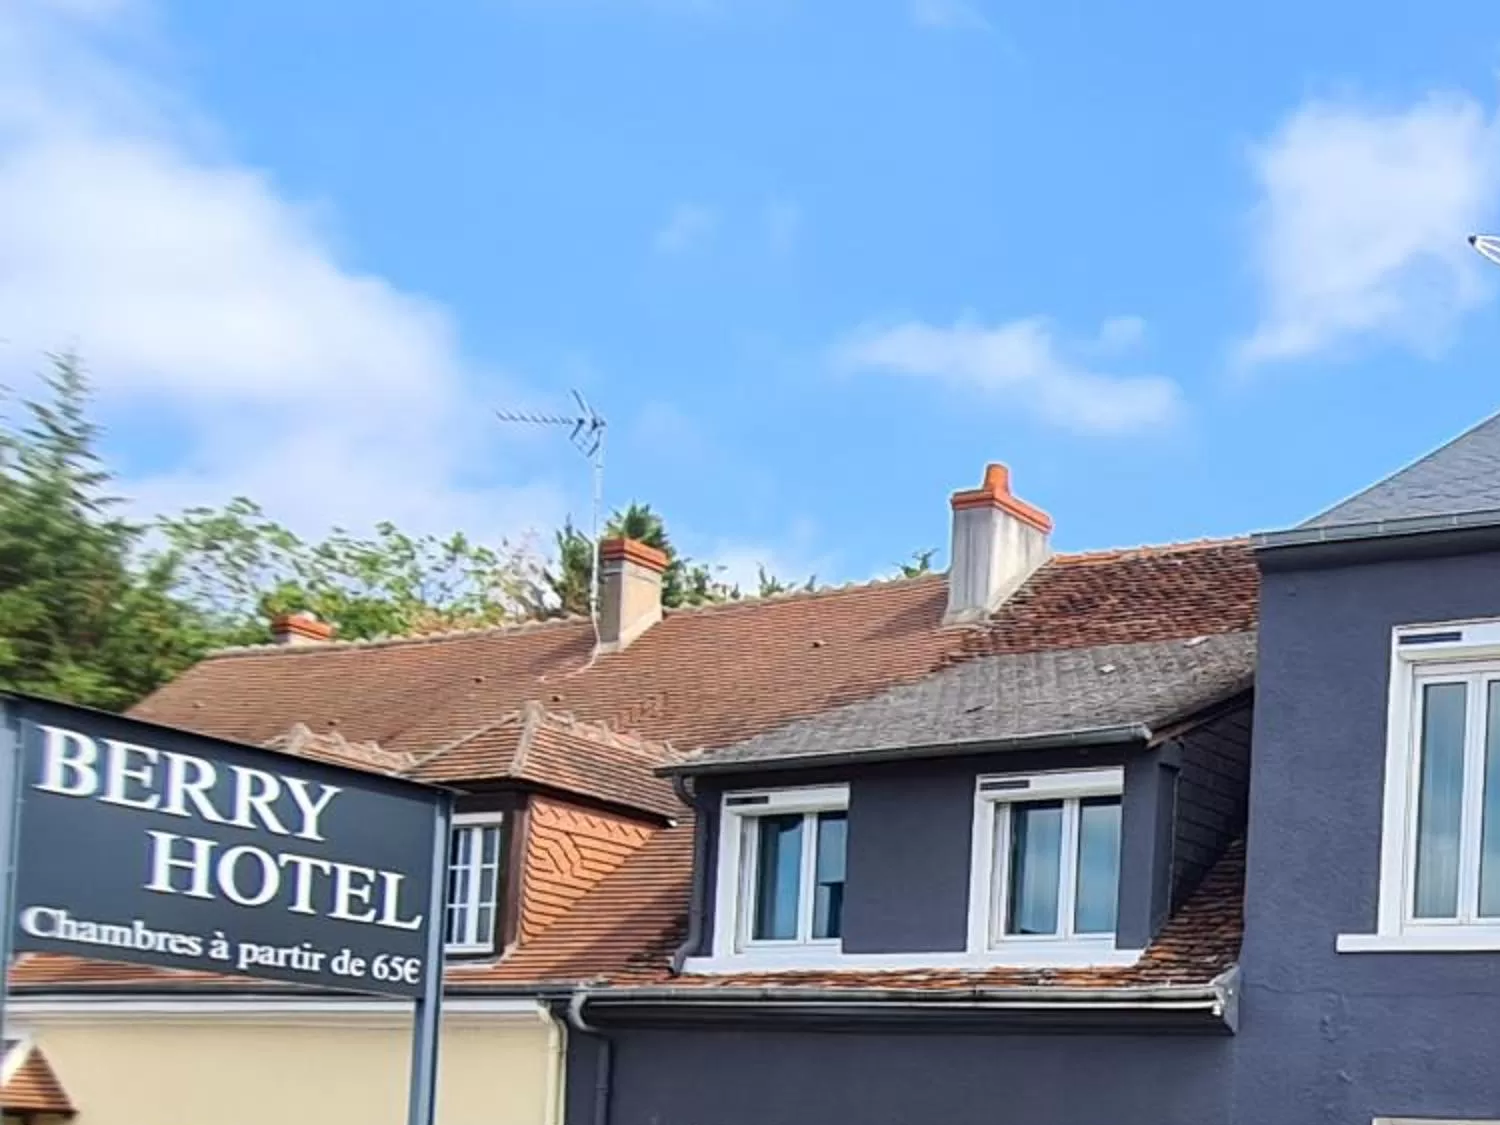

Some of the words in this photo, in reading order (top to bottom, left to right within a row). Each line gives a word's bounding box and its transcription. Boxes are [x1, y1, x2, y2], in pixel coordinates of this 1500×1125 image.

[32, 724, 342, 841] BERRY
[143, 829, 423, 931] HOTEL
[20, 905, 203, 957] Chambres
[208, 931, 230, 961] à
[238, 941, 326, 972] partir
[331, 949, 365, 977] de
[372, 954, 421, 984] 65€
